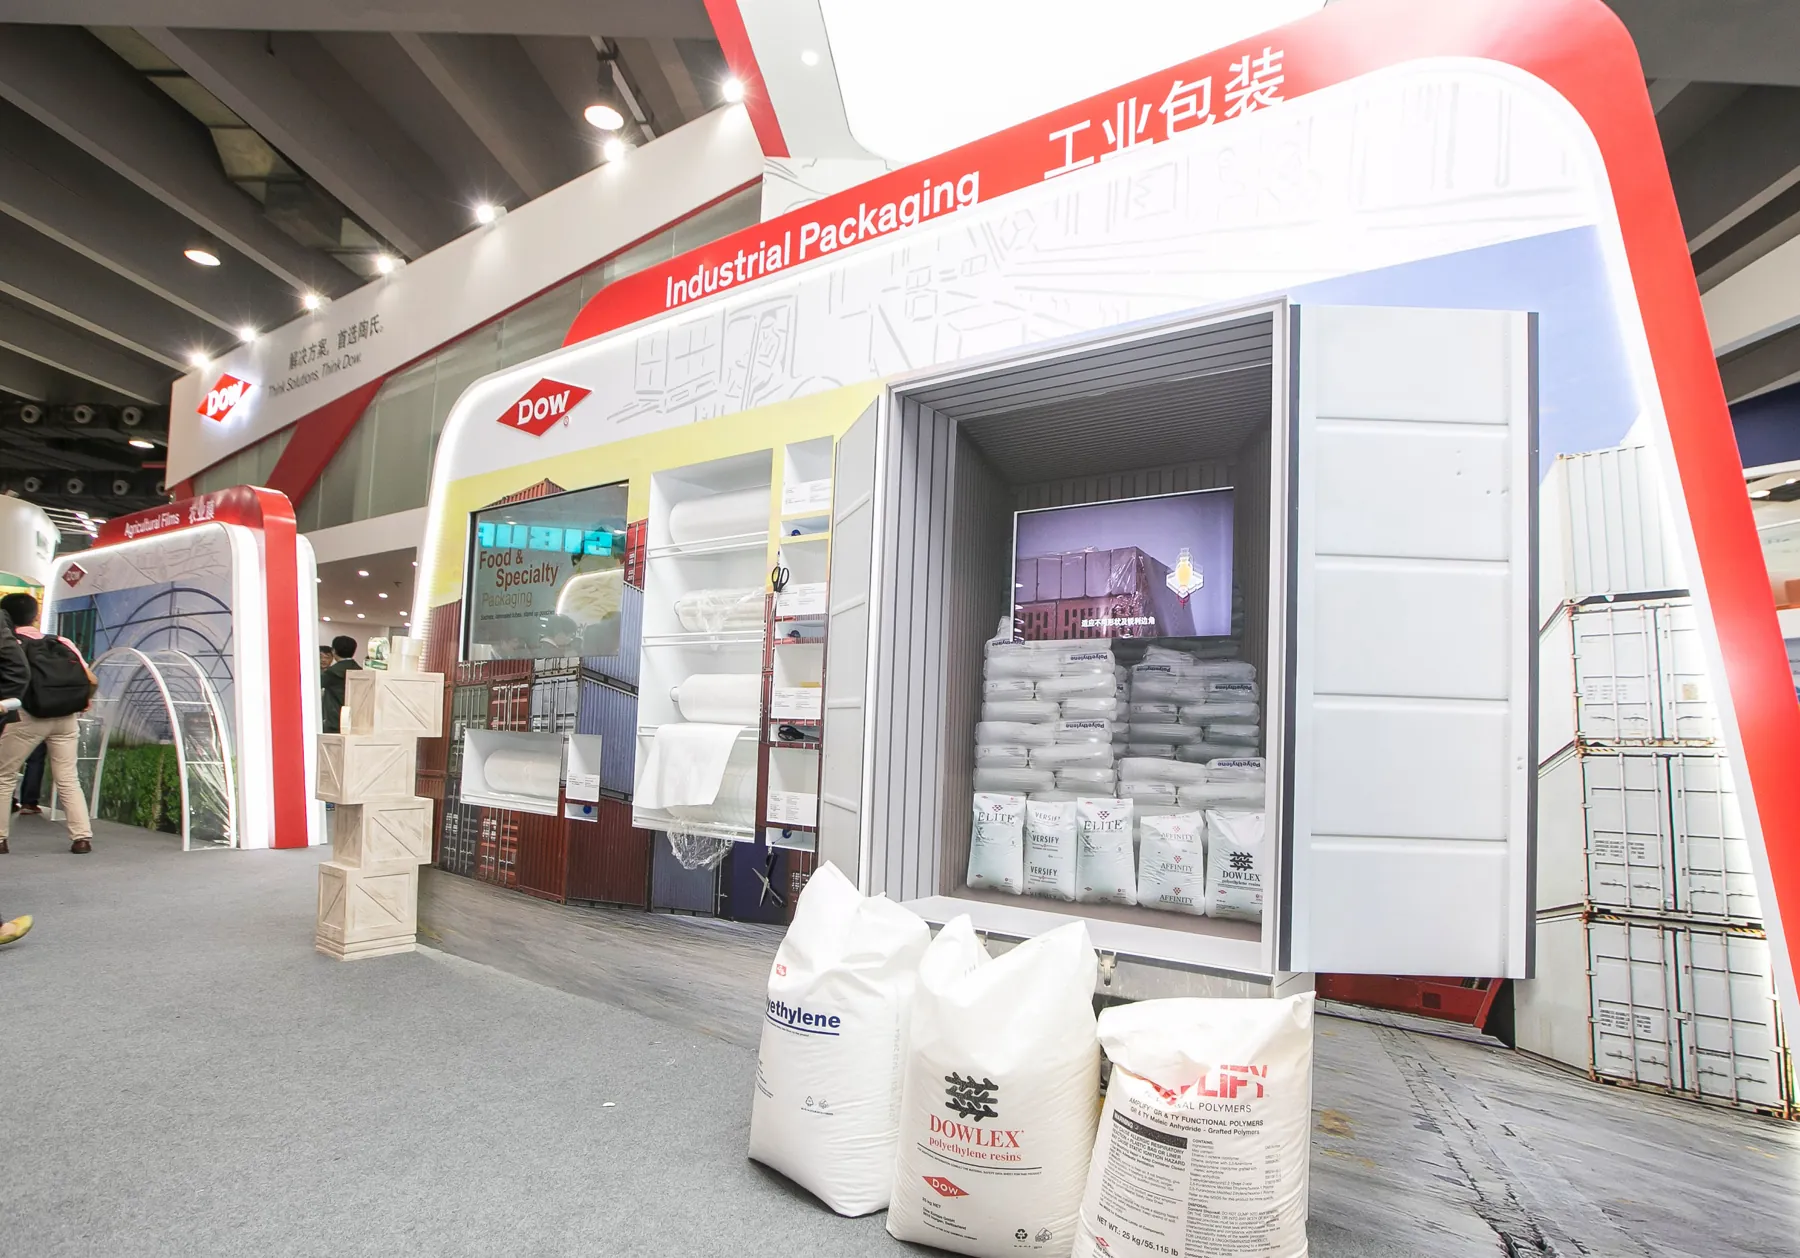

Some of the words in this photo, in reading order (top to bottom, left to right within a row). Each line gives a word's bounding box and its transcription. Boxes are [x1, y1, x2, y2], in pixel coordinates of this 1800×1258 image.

[1044, 45, 1287, 181] 工业包装
[665, 231, 792, 308] Industrial
[798, 169, 982, 264] Packaging
[321, 360, 342, 378] Think
[206, 381, 246, 417] DOW
[516, 390, 570, 426] DOW
[124, 515, 160, 539] Agricultural
[160, 512, 180, 528] Films
[479, 547, 512, 570] Food
[515, 549, 523, 565] &
[495, 562, 560, 592] Specialty
[482, 589, 533, 609] Packaging
[1070, 653, 1108, 661] Polyethylene
[1217, 760, 1261, 768] Polyethylene
[977, 811, 1015, 825] ELITE
[1083, 819, 1123, 831] ELITE
[1031, 834, 1060, 845] VERSIFY
[1030, 866, 1058, 877] VERSIFY
[1159, 862, 1194, 873] AFFINITY
[1222, 870, 1261, 882] DOWLEX
[1159, 894, 1194, 905] AFFINITY
[1198, 1102, 1252, 1113] POLYMERS
[1169, 1122, 1202, 1133] Anhydride
[1207, 1127, 1232, 1135] Grafted
[1181, 1116, 1228, 1127] FUNCTIONAL
[1229, 1119, 1264, 1128] POLYMERS
[929, 1113, 1021, 1149] DOWLEX
[929, 1136, 987, 1160] polyethylene
[989, 1149, 1022, 1162] resins
[1130, 1139, 1147, 1150] PLASTIC
[1166, 1152, 1182, 1160] LINER
[1150, 1142, 1185, 1155] RESPIRATORY
[1142, 1150, 1164, 1161] IGNITION
[1164, 1157, 1186, 1167] HAZARD
[931, 1178, 958, 1196] DOW
[1096, 1214, 1108, 1227] NET
[1122, 1230, 1131, 1240] 25
[1171, 1248, 1179, 1257] lb
